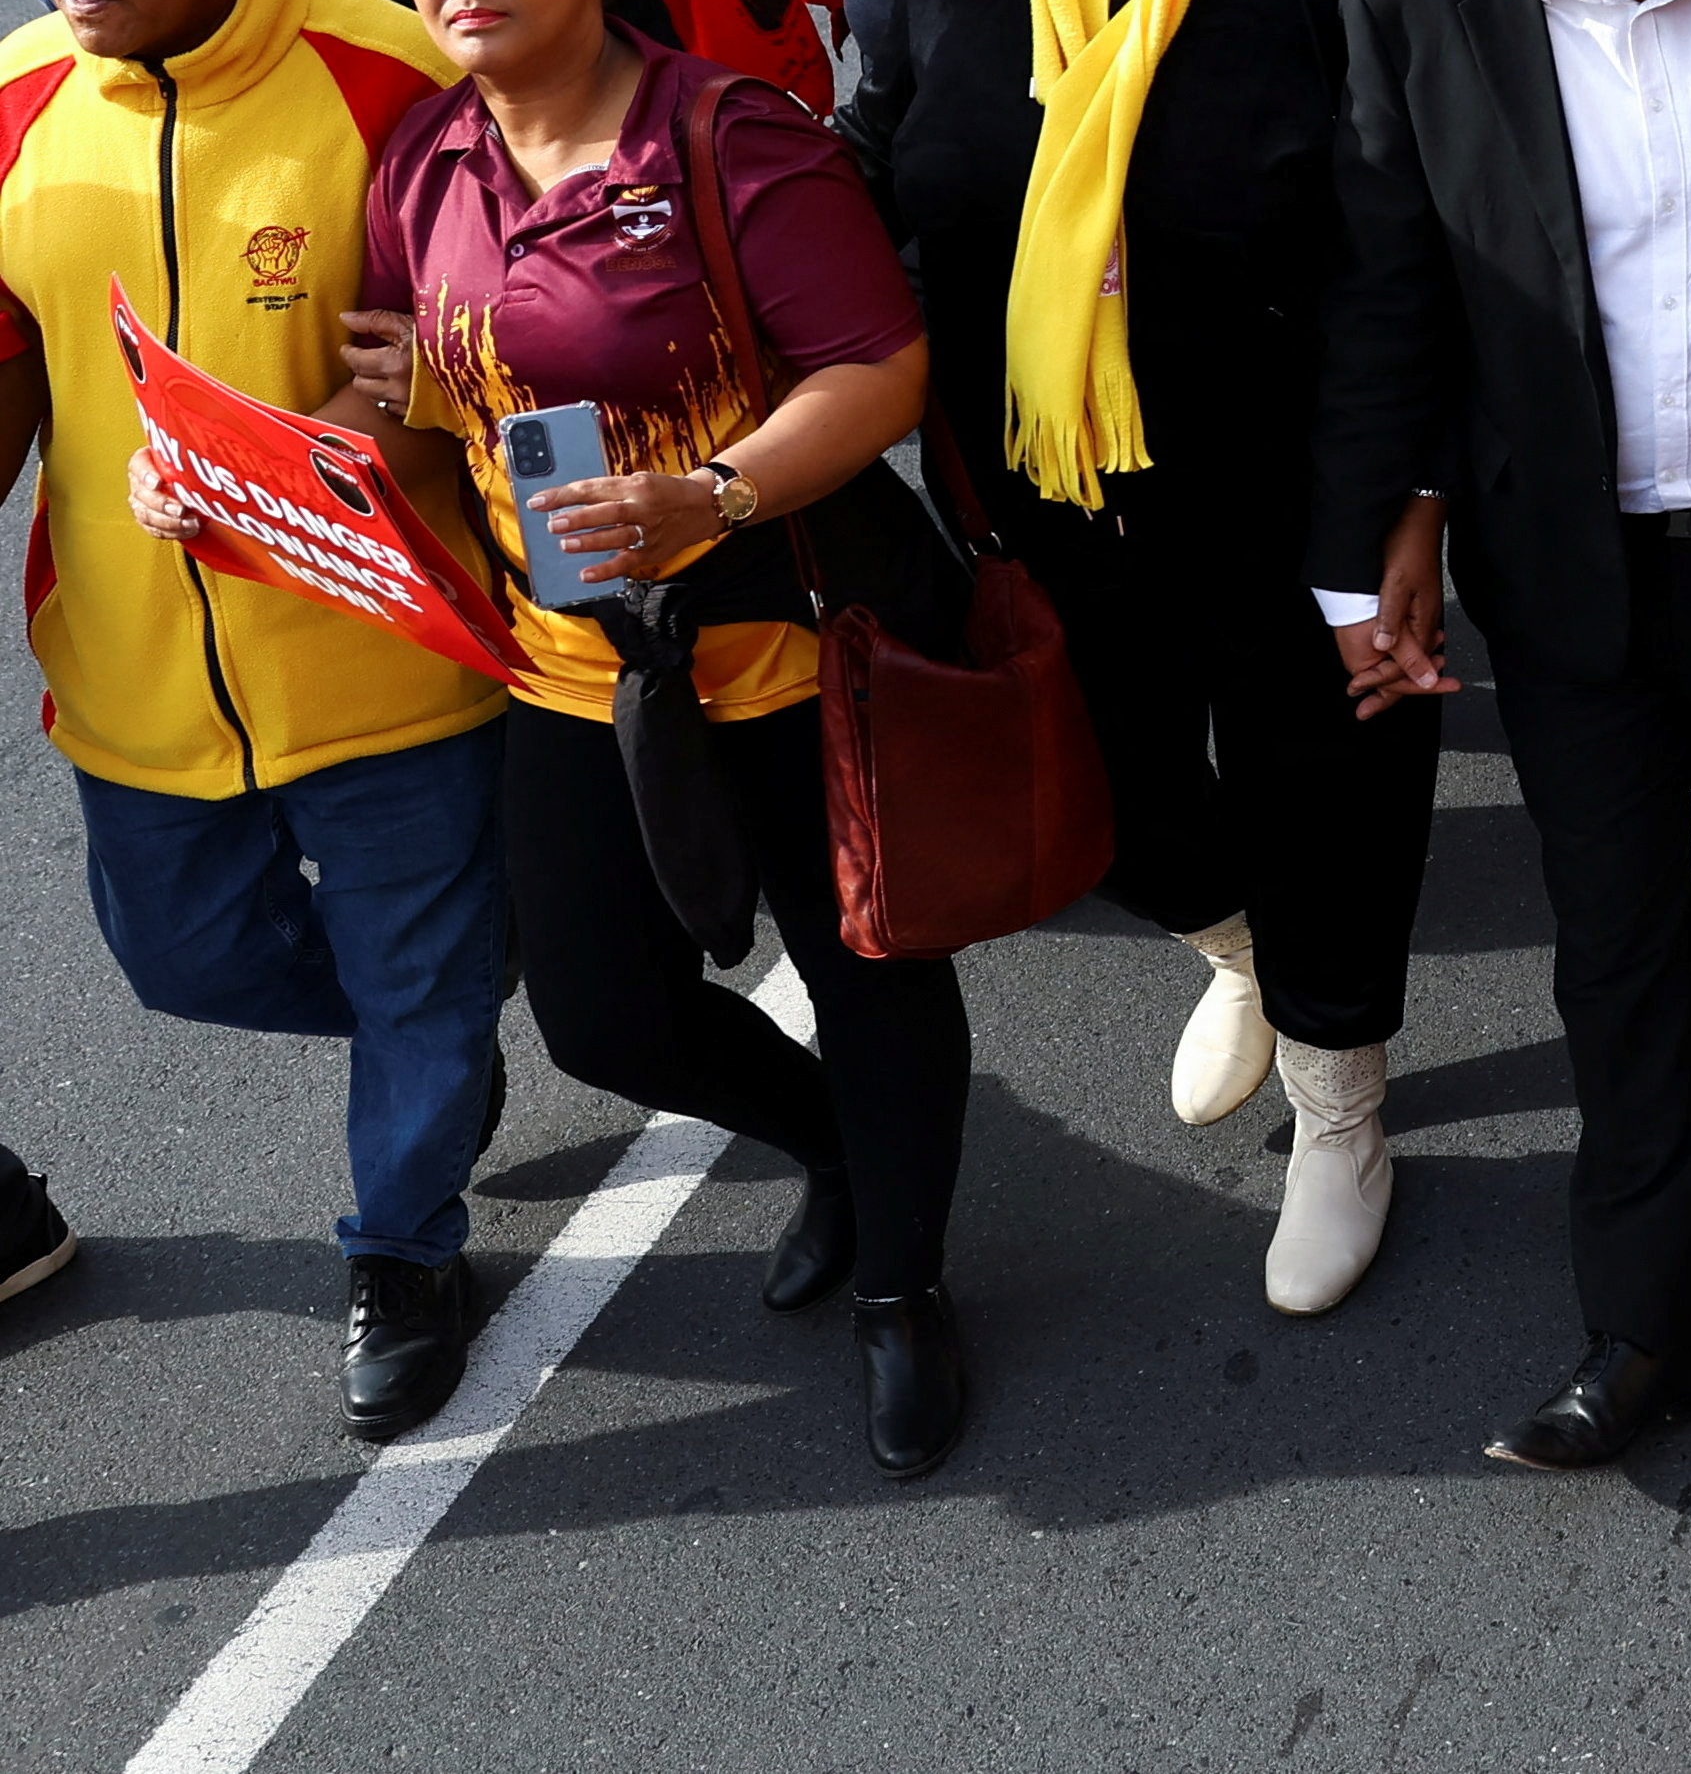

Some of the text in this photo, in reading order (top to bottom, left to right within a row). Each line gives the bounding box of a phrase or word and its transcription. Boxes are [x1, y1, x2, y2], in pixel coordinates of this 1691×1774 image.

[245, 293, 287, 306] WESTERN
[252, 277, 298, 288] SACTWU
[263, 302, 292, 312] STAFF
[187, 449, 429, 587] US DANGER
[173, 481, 424, 614] ALLOWANCE
[267, 549, 397, 623] NOW!
